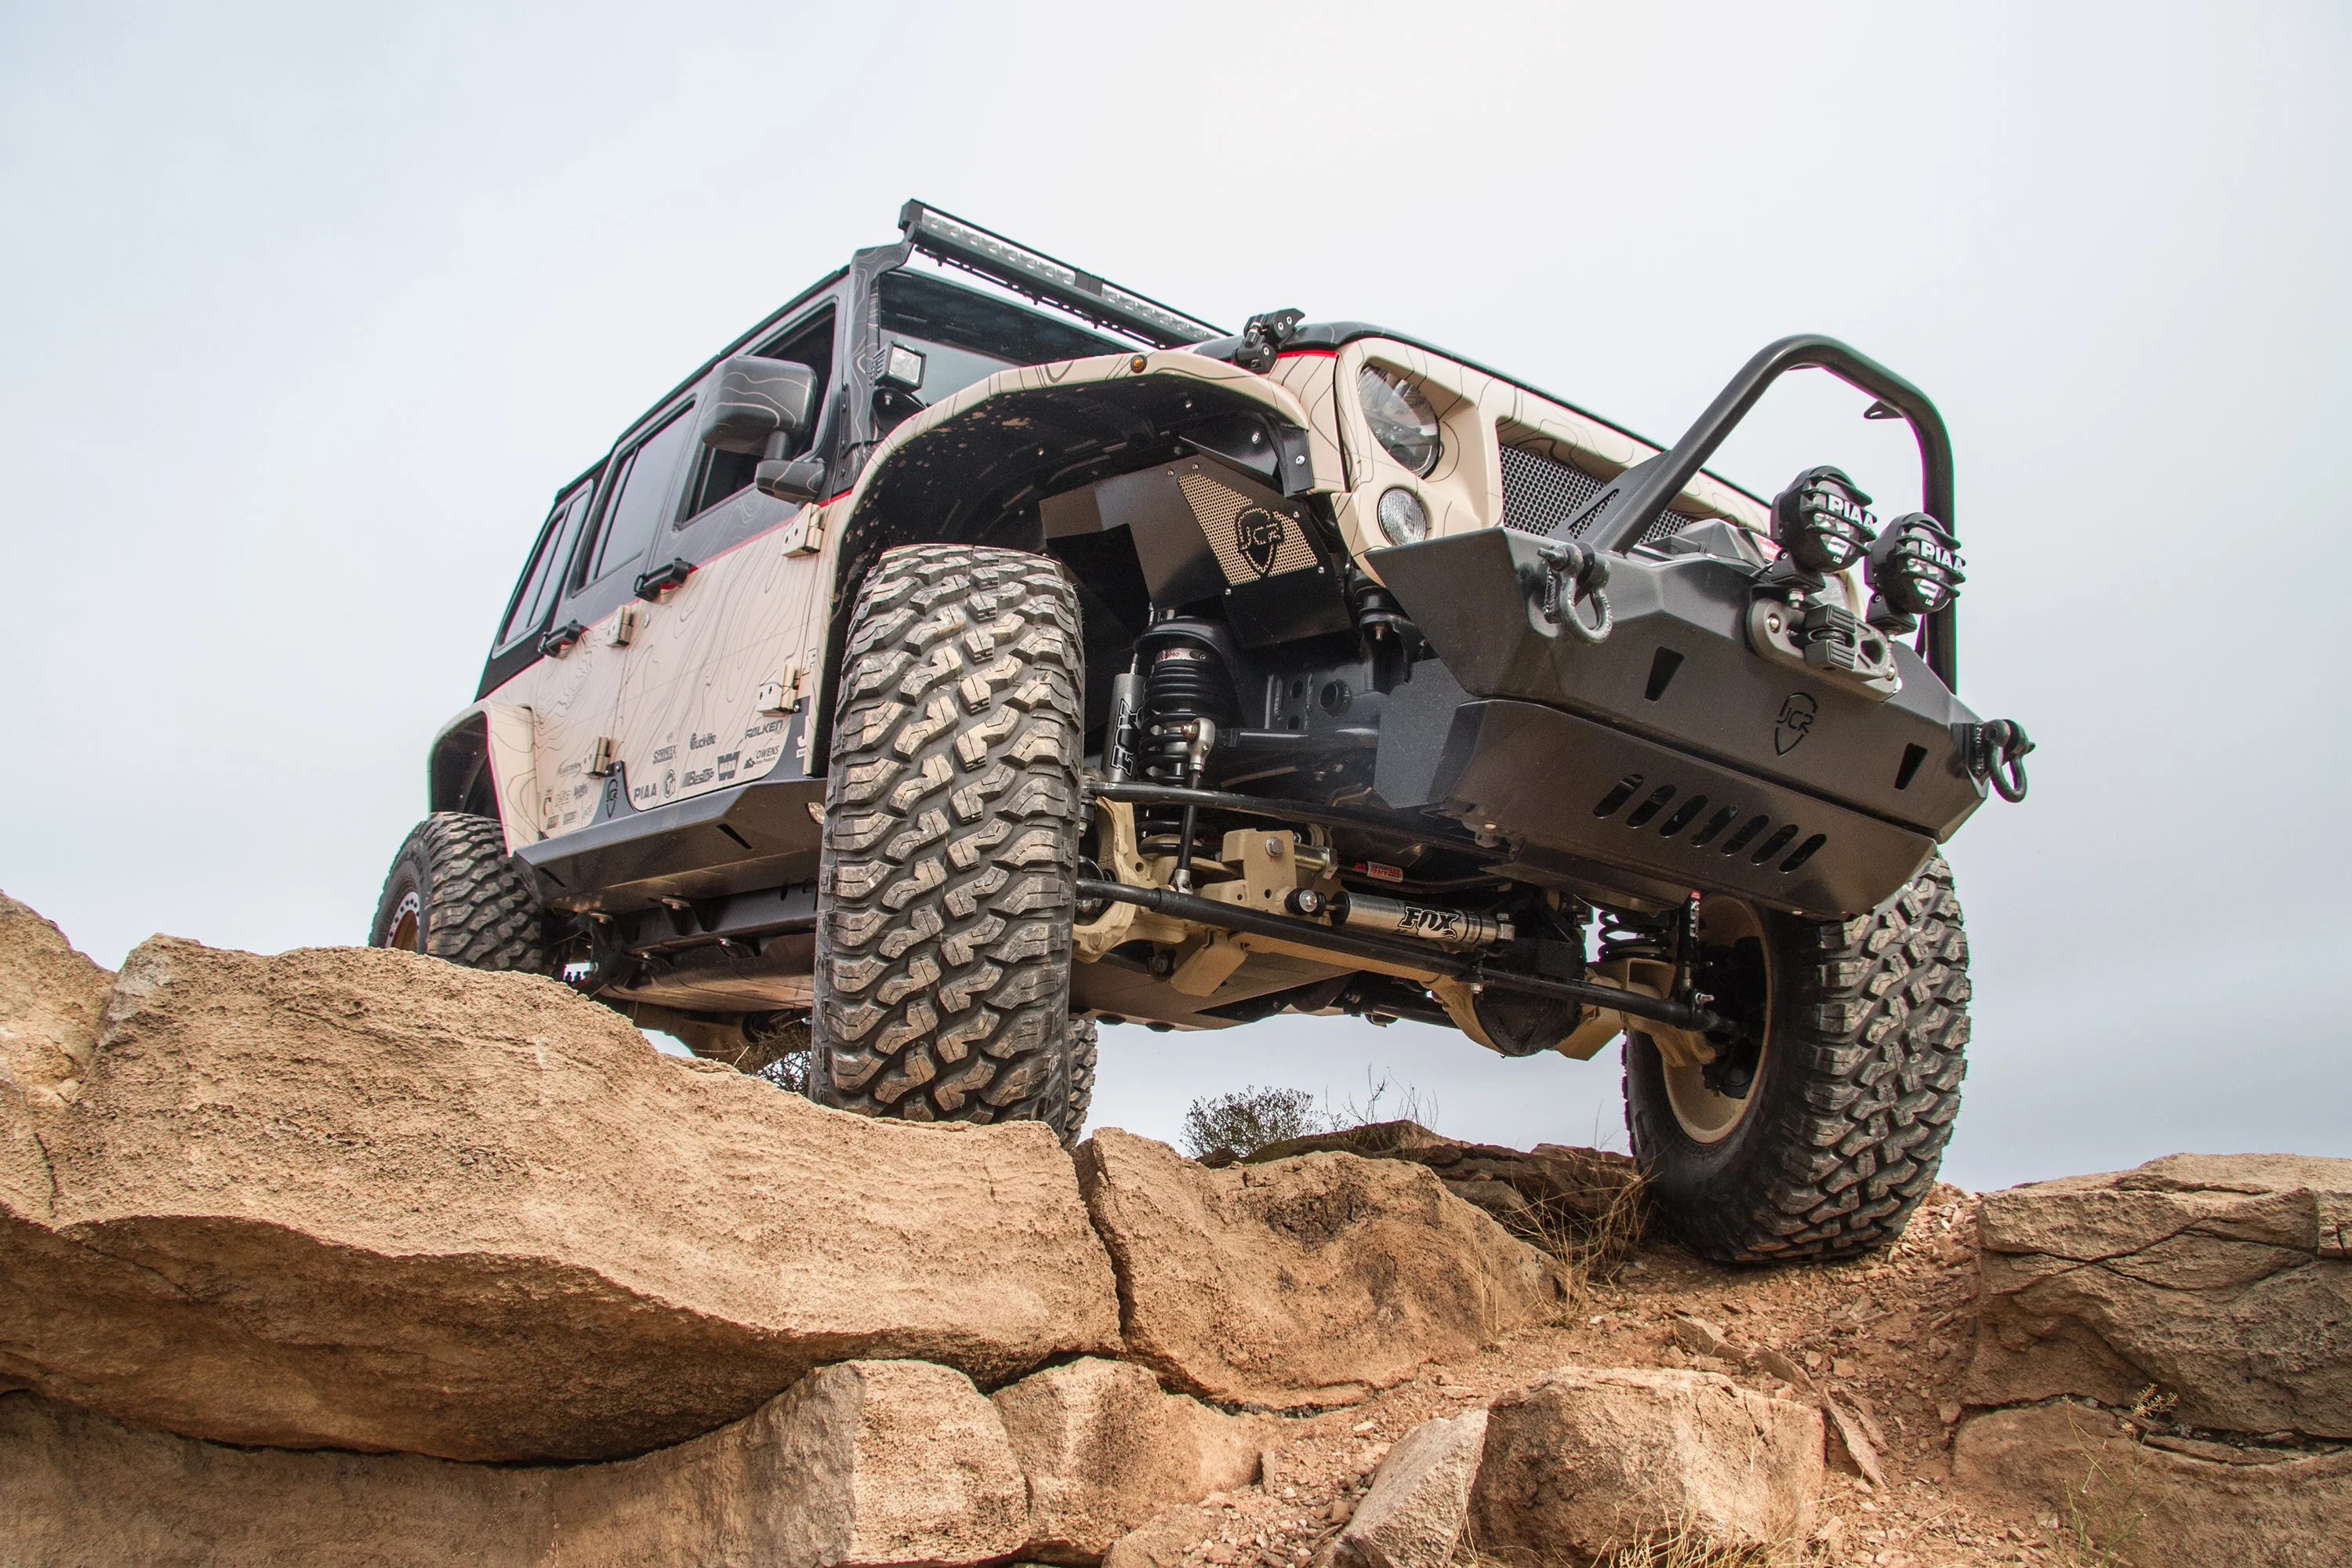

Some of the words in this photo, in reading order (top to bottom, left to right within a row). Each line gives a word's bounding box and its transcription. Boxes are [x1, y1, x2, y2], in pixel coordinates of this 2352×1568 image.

[1828, 494, 1875, 528] PIAA
[1832, 555, 1842, 564] LED
[1921, 540, 1964, 573] PIAA
[1925, 598, 1934, 607] LED
[1776, 707, 1814, 734] JCR
[756, 746, 779, 759] OWENS
[633, 783, 657, 801] PIAA
[1398, 906, 1459, 935] FOX
